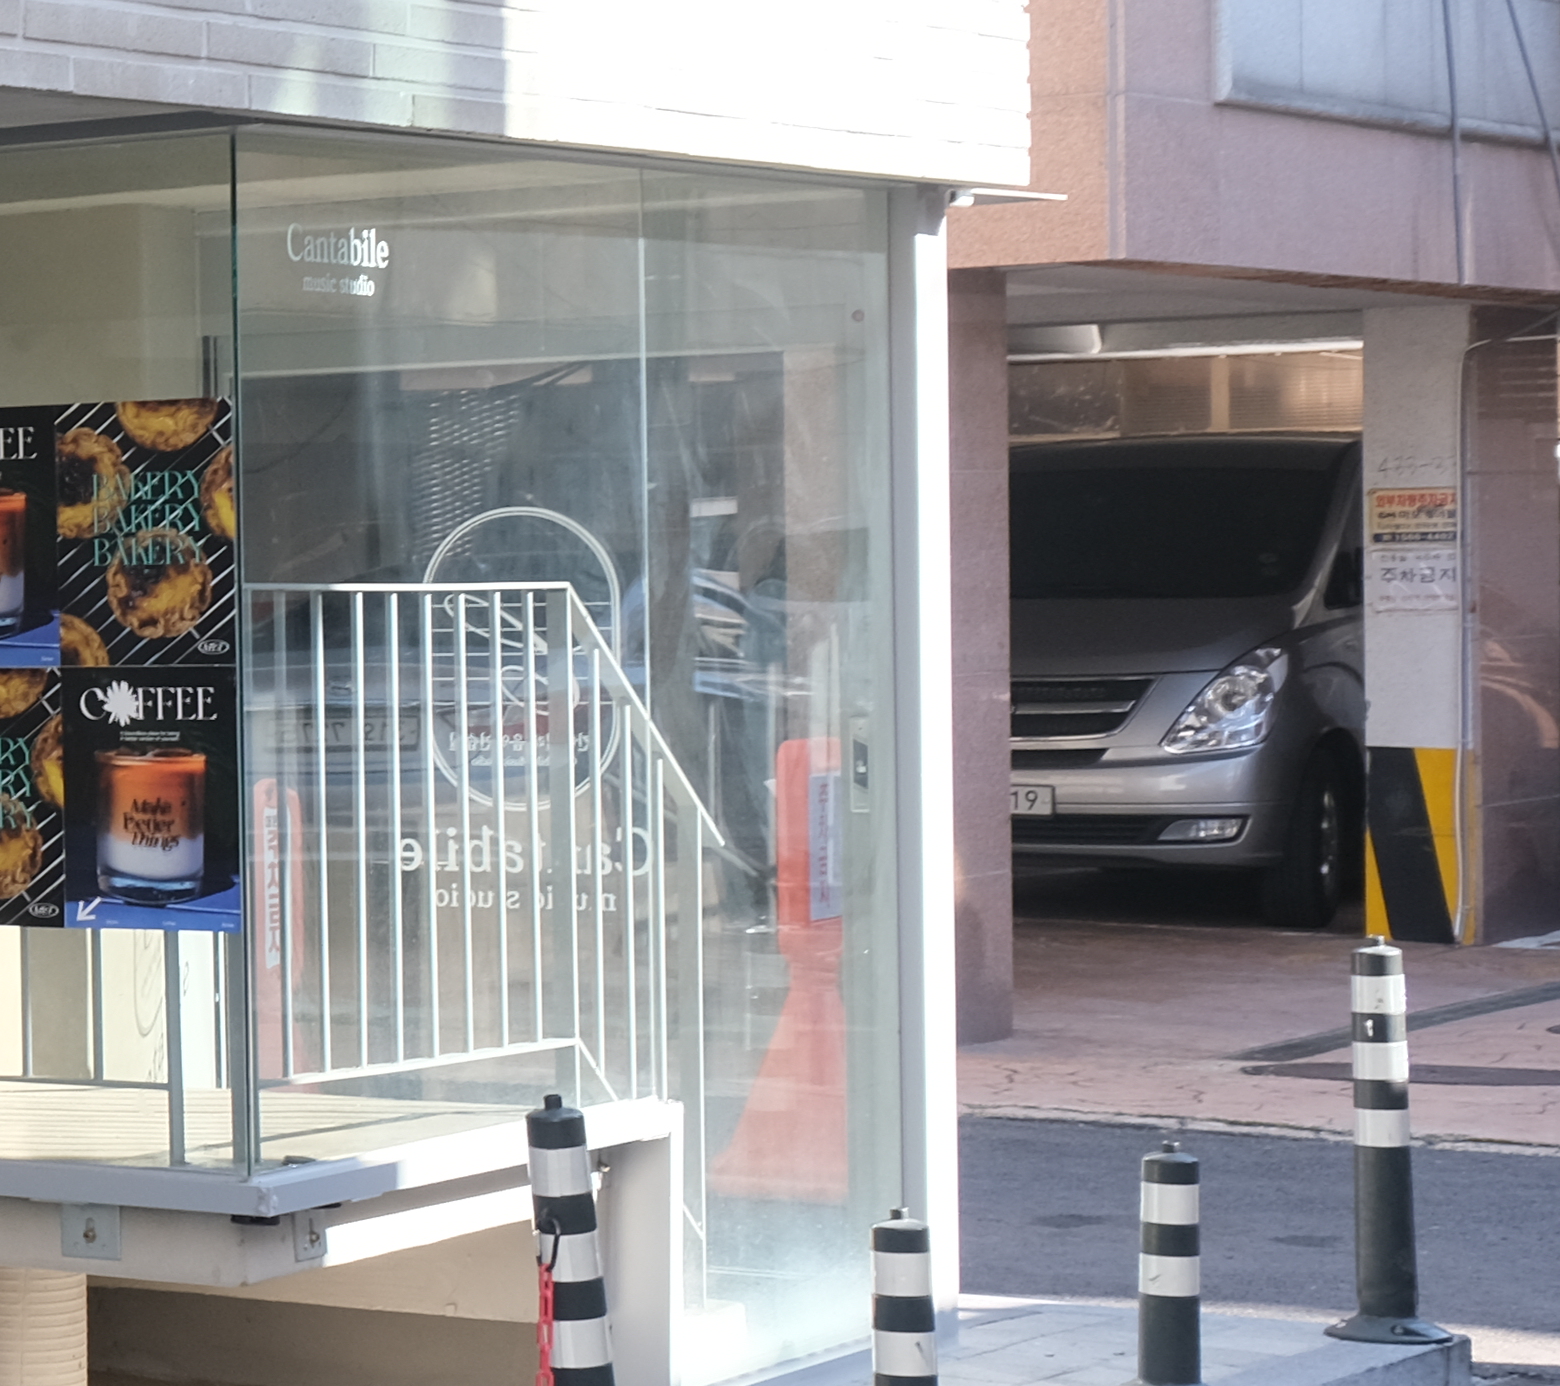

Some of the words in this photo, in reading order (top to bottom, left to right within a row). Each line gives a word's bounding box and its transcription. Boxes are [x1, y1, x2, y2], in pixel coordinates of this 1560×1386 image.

[287, 222, 389, 269] Cantabile
[303, 273, 337, 293] music
[339, 274, 375, 296] studio
[92, 470, 200, 500] BAKERY
[93, 503, 200, 534] BAKERY
[94, 536, 203, 567] BAKERY
[1381, 567, 1456, 583] 주차금지
[80, 686, 218, 721] CFFEE
